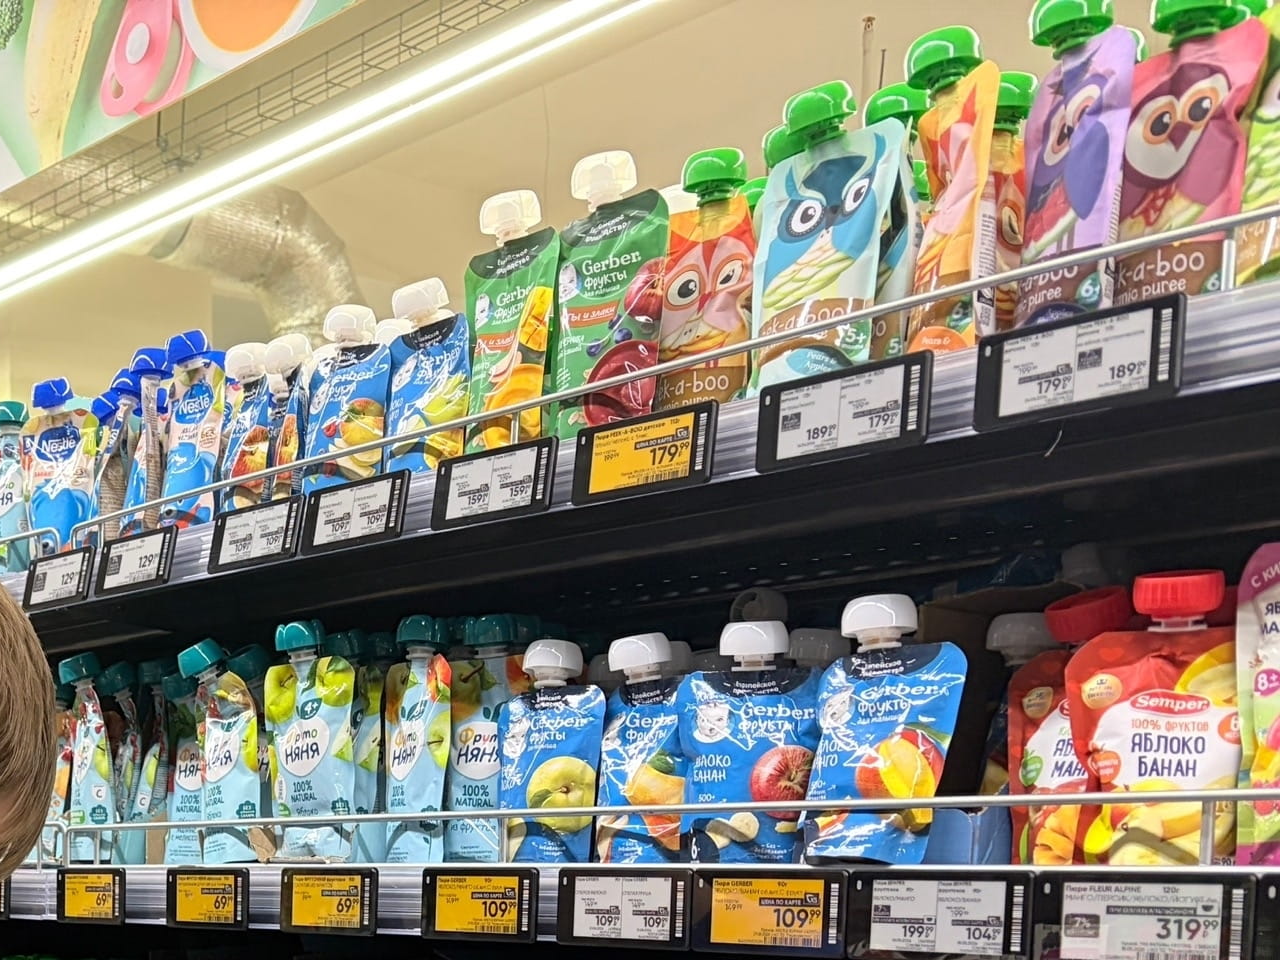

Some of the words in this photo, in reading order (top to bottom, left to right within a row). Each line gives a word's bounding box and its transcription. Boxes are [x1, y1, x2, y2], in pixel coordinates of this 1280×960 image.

[582, 251, 642, 276] Gerber
[1142, 277, 1187, 300] puree
[649, 444, 679, 466] 179
[1131, 719, 1162, 731] 100%
[1165, 720, 1209, 733] ФРУКТОВ
[1130, 732, 1206, 755] ЯБЛОКО
[284, 743, 320, 765] НЯНЯ
[1137, 755, 1197, 778] БАНАН
[694, 767, 727, 783] БАНАН
[293, 780, 313, 793] 100%
[462, 784, 489, 797] 100%
[291, 792, 317, 803] NATURAL
[455, 797, 494, 808] NATURAL
[1089, 884, 1113, 893] FLEUR
[213, 895, 228, 910] 69
[335, 898, 352, 913] 69
[482, 901, 508, 918] 109
[596, 915, 612, 927] 109
[643, 916, 661, 928] 109
[773, 908, 809, 928] 109
[901, 925, 925, 938] 199
[965, 927, 992, 941] 104
[1156, 918, 1202, 940] 319
[1203, 919, 1219, 931] 99
